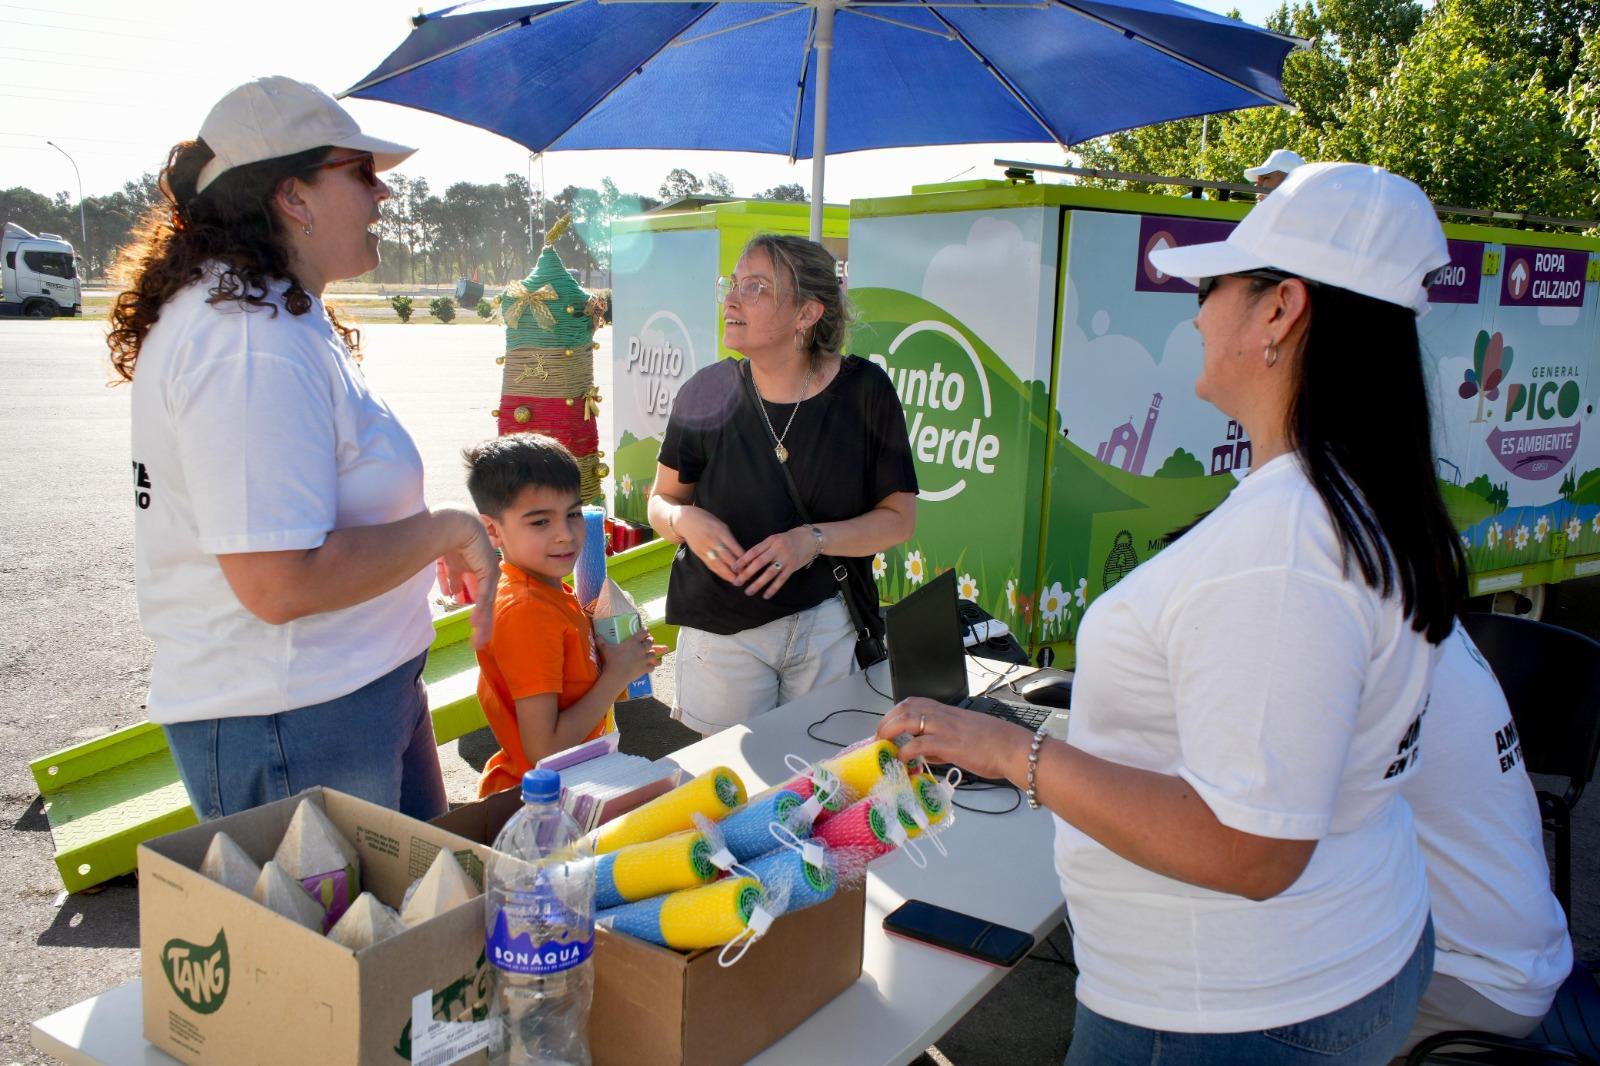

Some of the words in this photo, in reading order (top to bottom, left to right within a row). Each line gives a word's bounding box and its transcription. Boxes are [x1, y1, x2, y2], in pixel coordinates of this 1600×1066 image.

[1535, 253, 1565, 273] ROPA
[1532, 280, 1581, 299] CALZADO
[627, 336, 683, 377] Punto
[1532, 366, 1580, 378] GENERAL
[1505, 380, 1580, 422] PICO
[1501, 437, 1515, 455] ES
[1516, 433, 1574, 454] AMBIENTE
[1499, 754, 1516, 774] EN
[495, 946, 580, 965] BONAQUA
[168, 948, 225, 1003] TANG
